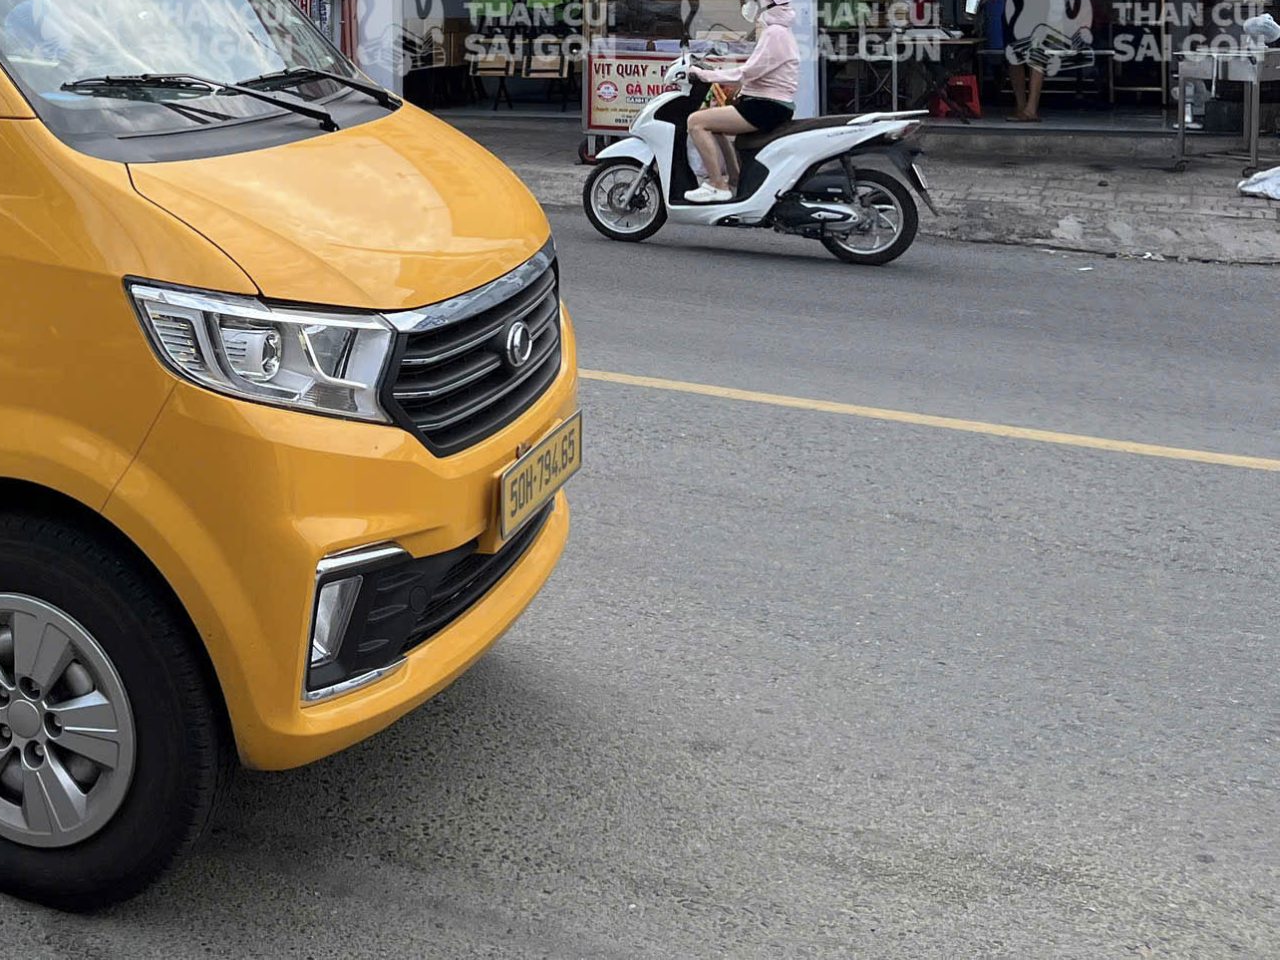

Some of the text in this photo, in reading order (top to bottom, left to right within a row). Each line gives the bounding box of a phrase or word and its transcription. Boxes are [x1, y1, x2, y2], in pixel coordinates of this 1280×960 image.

[593, 62, 612, 79] VỊT
[616, 63, 648, 79] QUAY
[626, 81, 642, 96] GÀ
